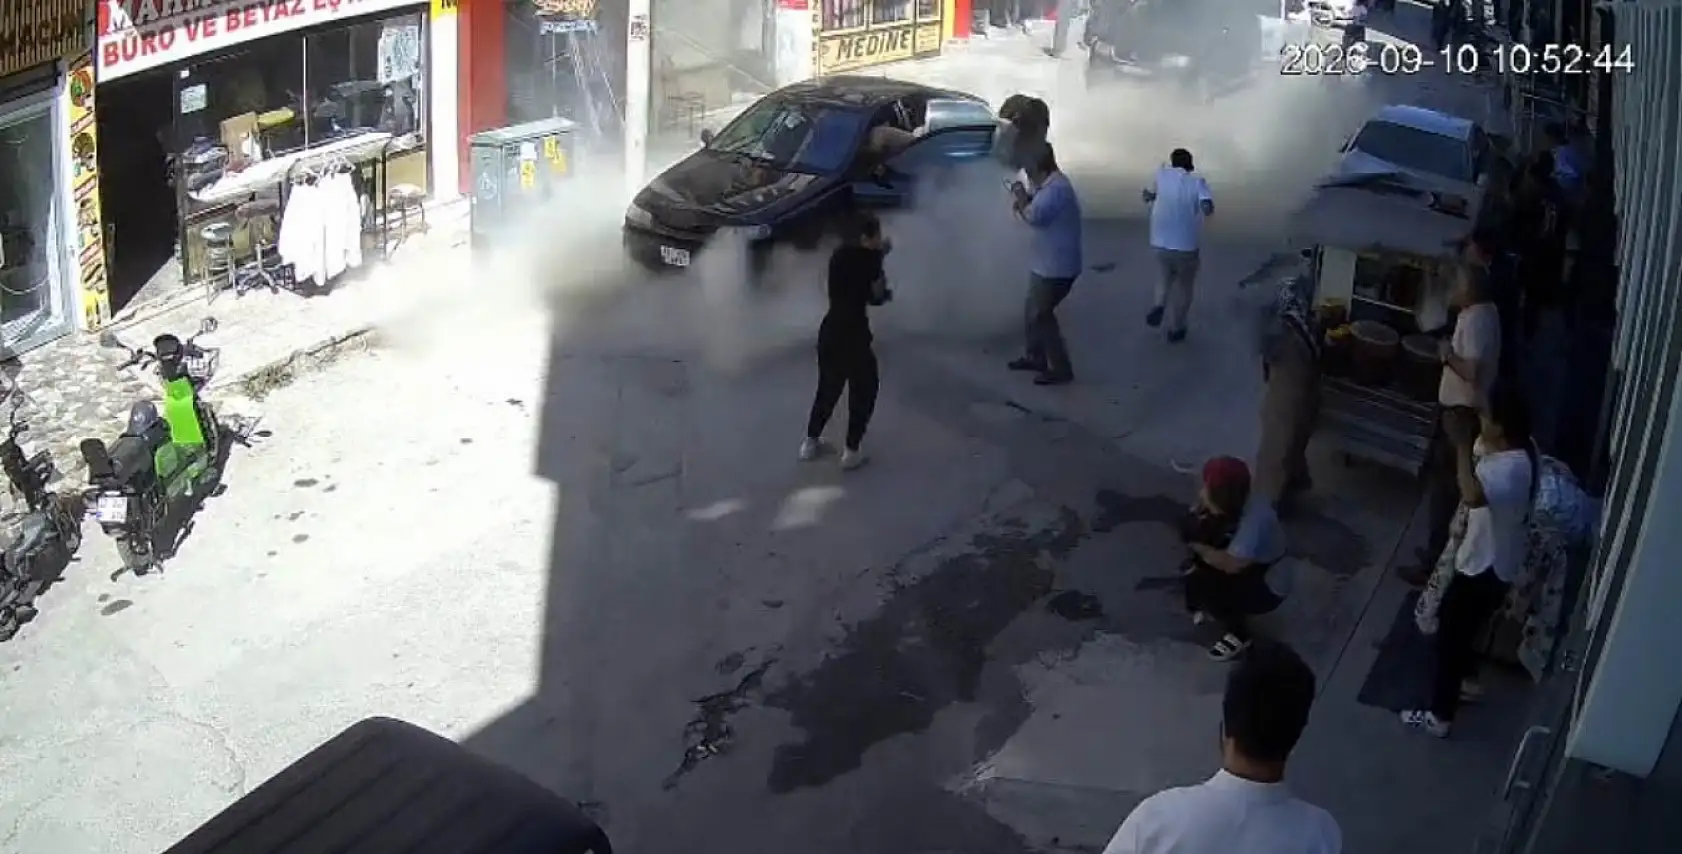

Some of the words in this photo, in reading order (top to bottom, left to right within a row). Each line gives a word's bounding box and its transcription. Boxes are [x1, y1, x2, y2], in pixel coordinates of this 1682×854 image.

[103, 24, 176, 67] BÜRO
[183, 12, 217, 41] VE
[227, 0, 305, 32] BEYAZ
